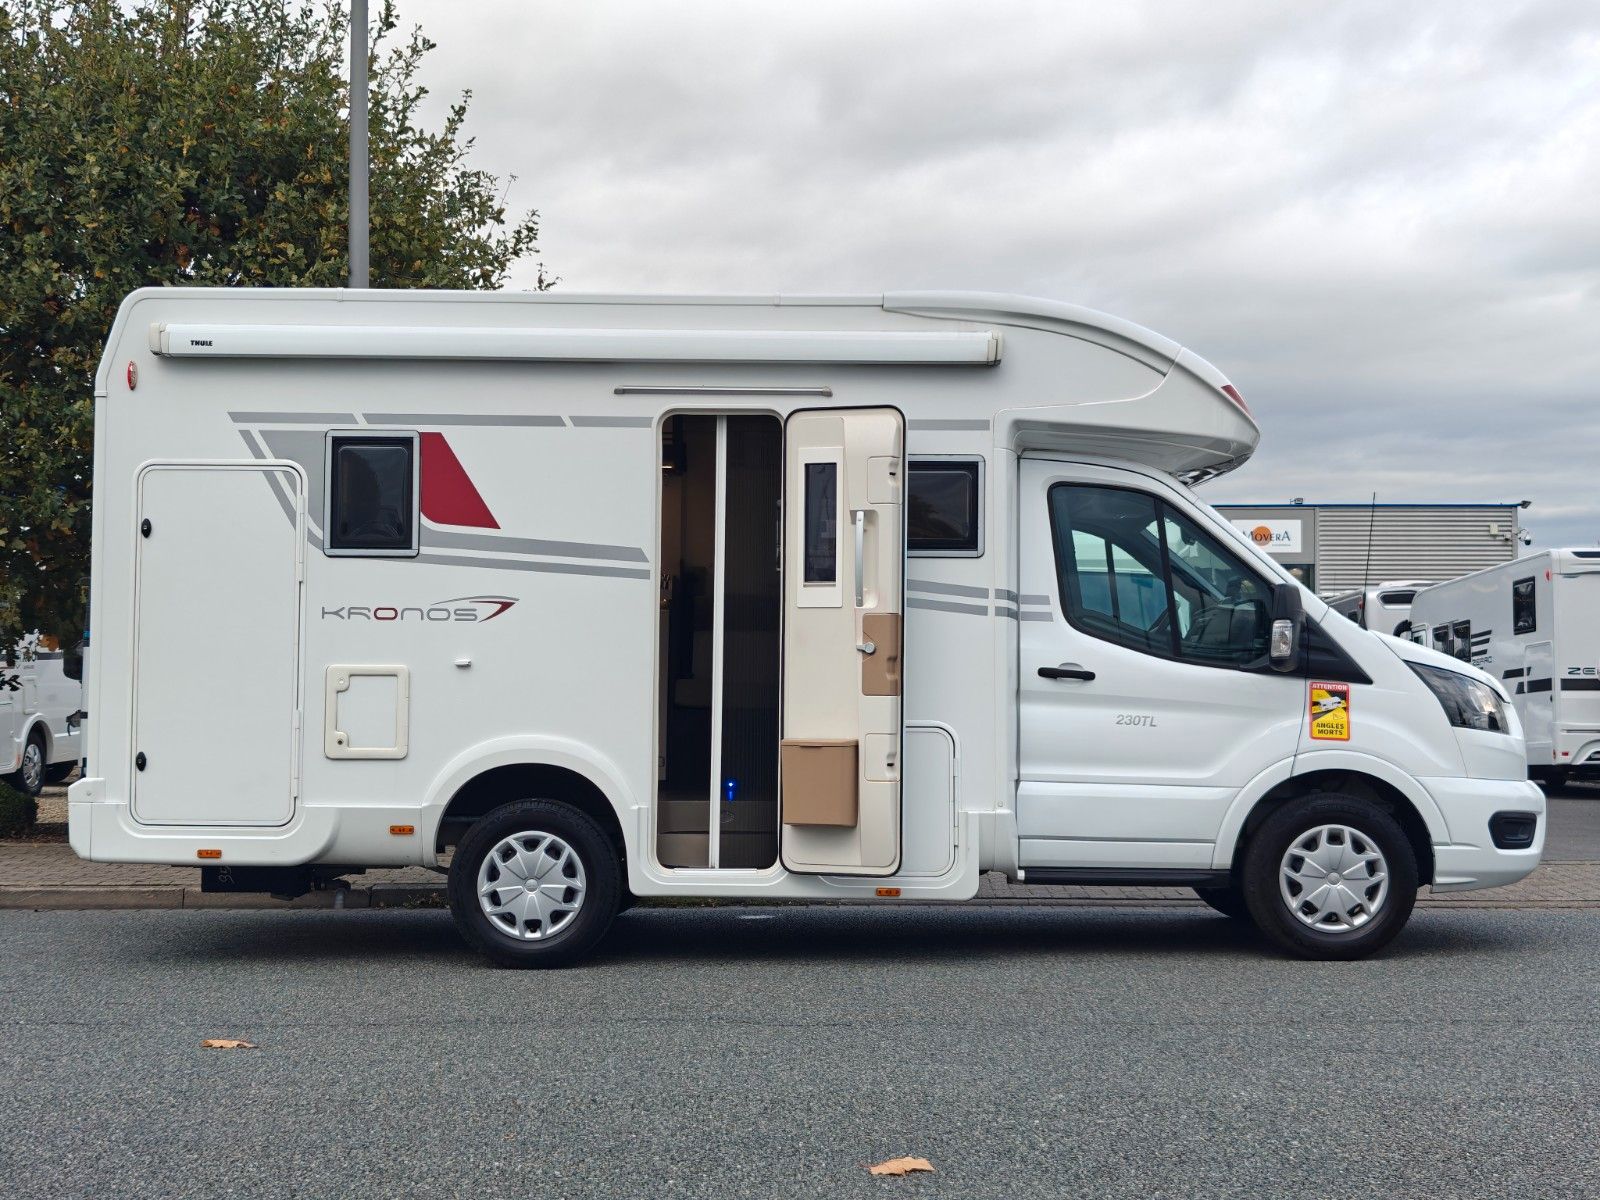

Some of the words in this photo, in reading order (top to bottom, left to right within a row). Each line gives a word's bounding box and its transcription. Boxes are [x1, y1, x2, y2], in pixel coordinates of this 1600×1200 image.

[321, 606, 478, 622] KRONOS
[1567, 667, 1600, 675] ZE
[1115, 714, 1157, 727] 230TL
[1316, 722, 1345, 730] ANGLES
